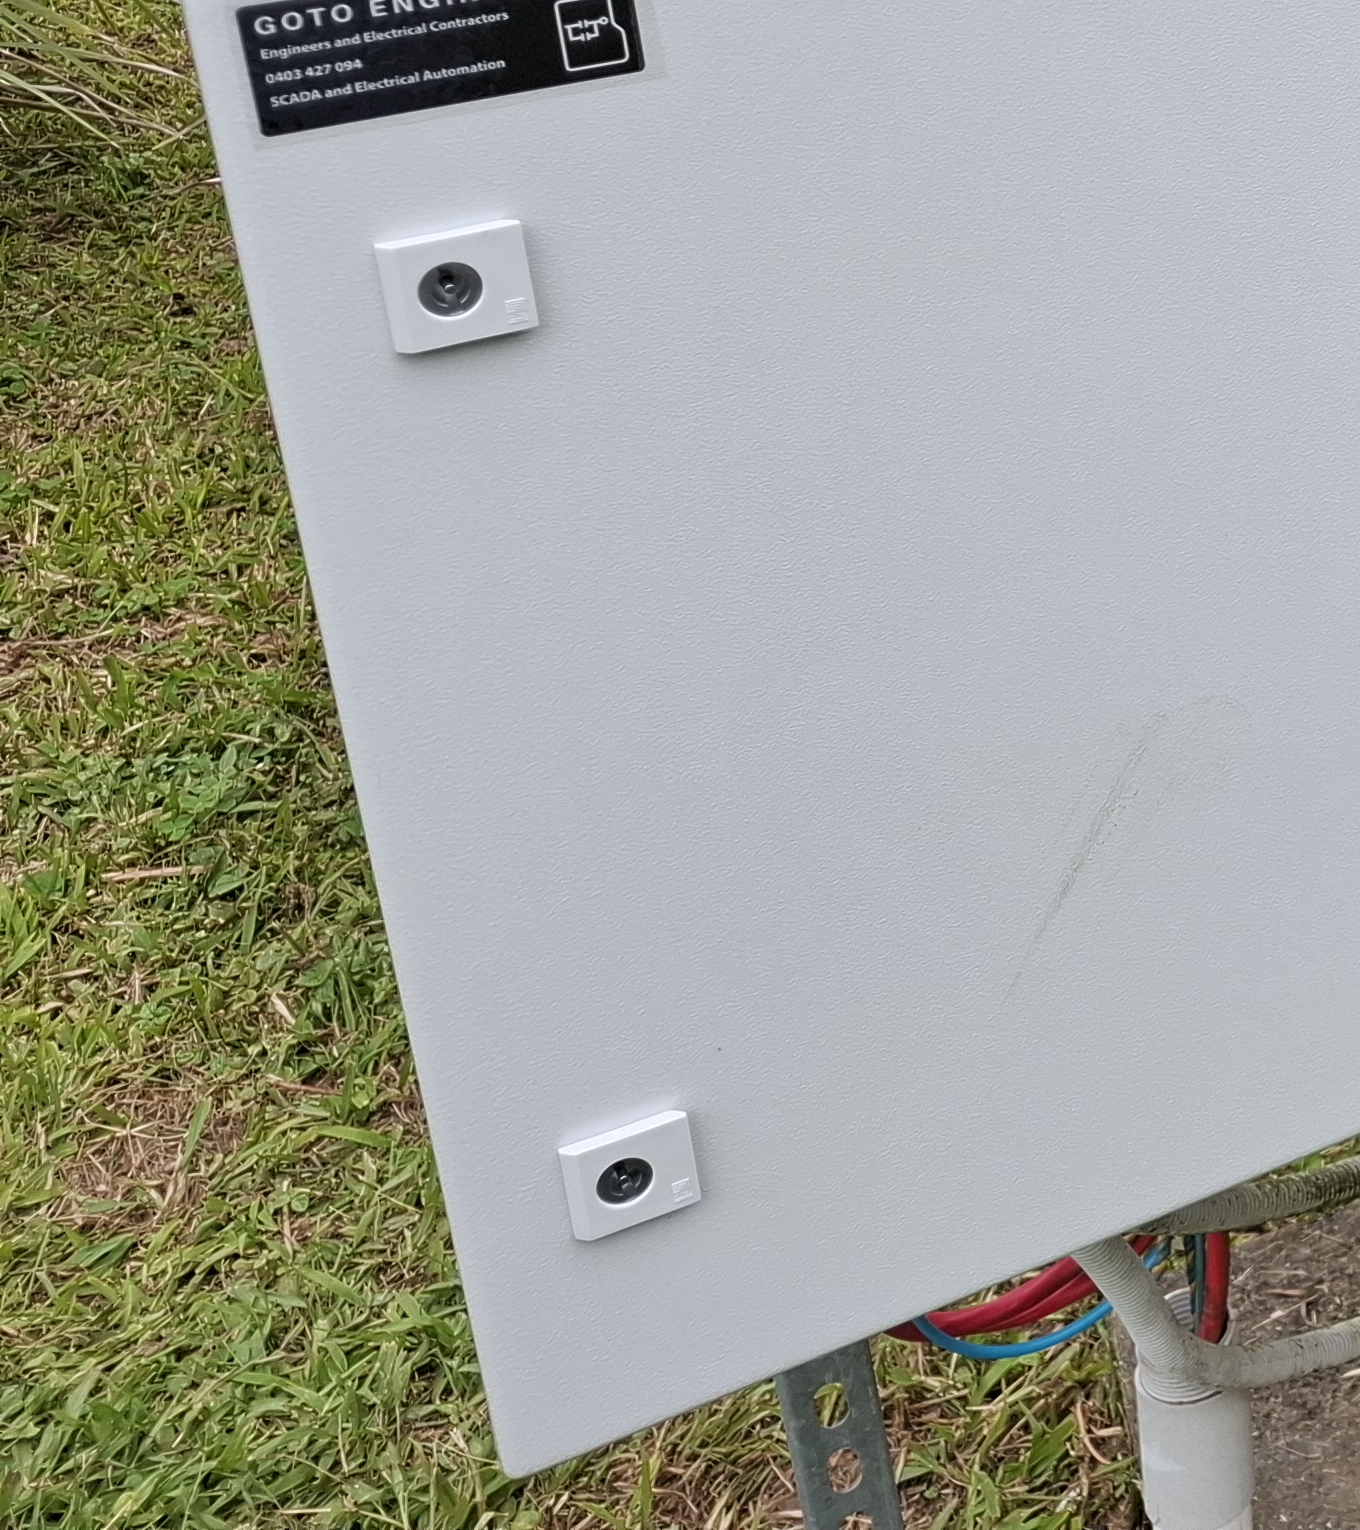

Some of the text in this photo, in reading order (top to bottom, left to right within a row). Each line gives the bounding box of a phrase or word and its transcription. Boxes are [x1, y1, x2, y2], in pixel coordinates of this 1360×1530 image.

[254, 3, 354, 35] GOTO
[260, 11, 510, 59] Engineers and Electrical Contractors
[265, 58, 363, 84] 0403 427 094
[270, 59, 506, 107] SCADA and Electrical Automation
